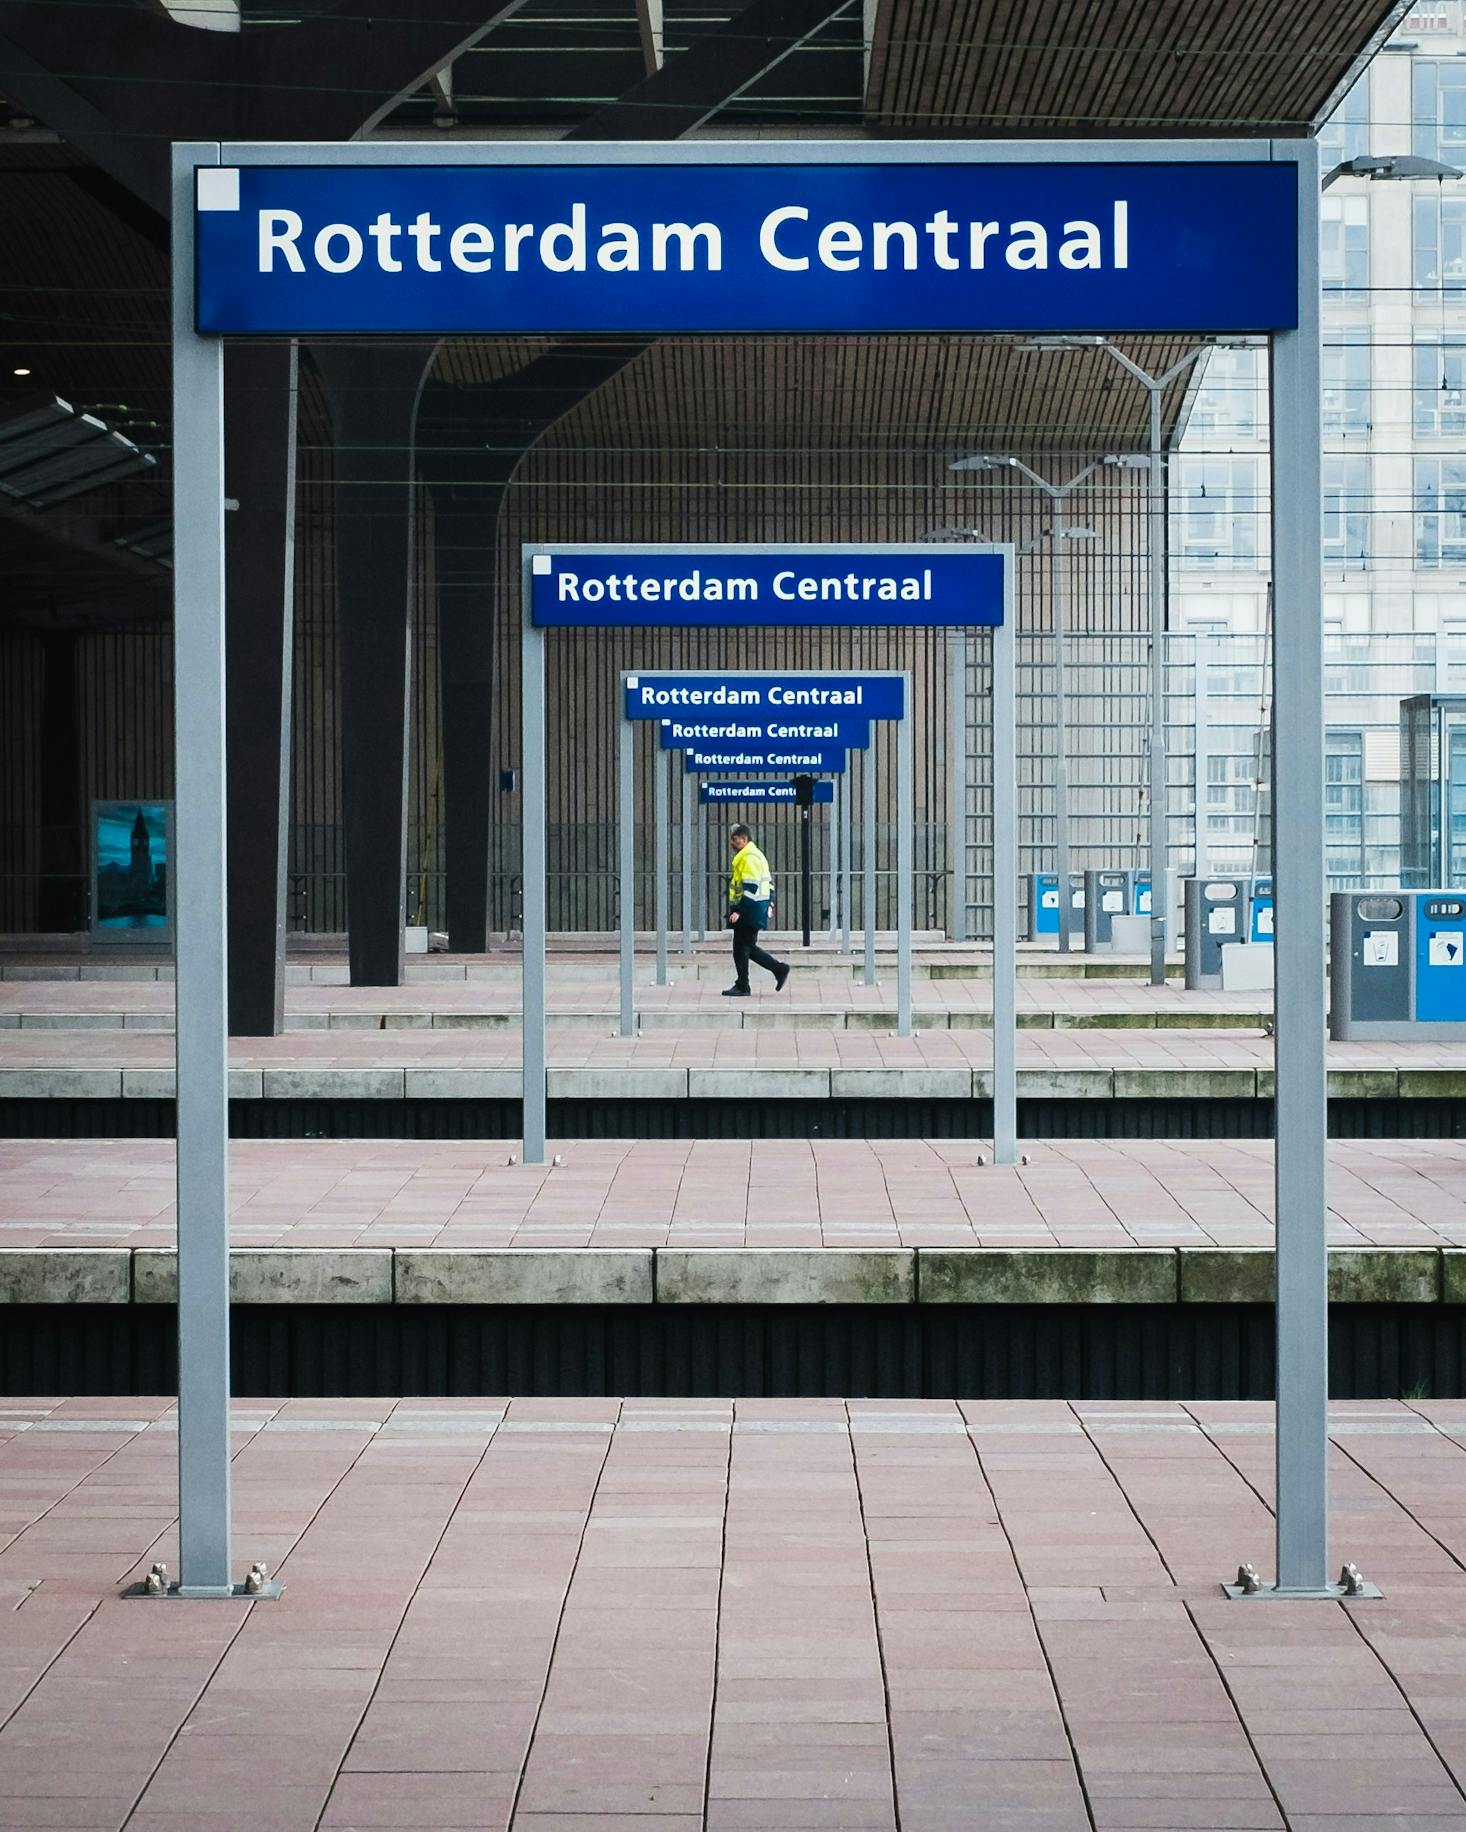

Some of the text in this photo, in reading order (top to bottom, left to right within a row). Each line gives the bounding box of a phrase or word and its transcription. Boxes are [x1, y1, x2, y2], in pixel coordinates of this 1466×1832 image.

[259, 200, 1128, 274] Rotterdam Centraal
[559, 569, 932, 602] Rotterdam Centraal
[642, 685, 863, 705] Rotterdam Centraal
[673, 722, 838, 738] Rotterdam Centraal
[695, 753, 822, 765] Rotterdam Centraal
[709, 786, 796, 797] Rotterdam Cent
